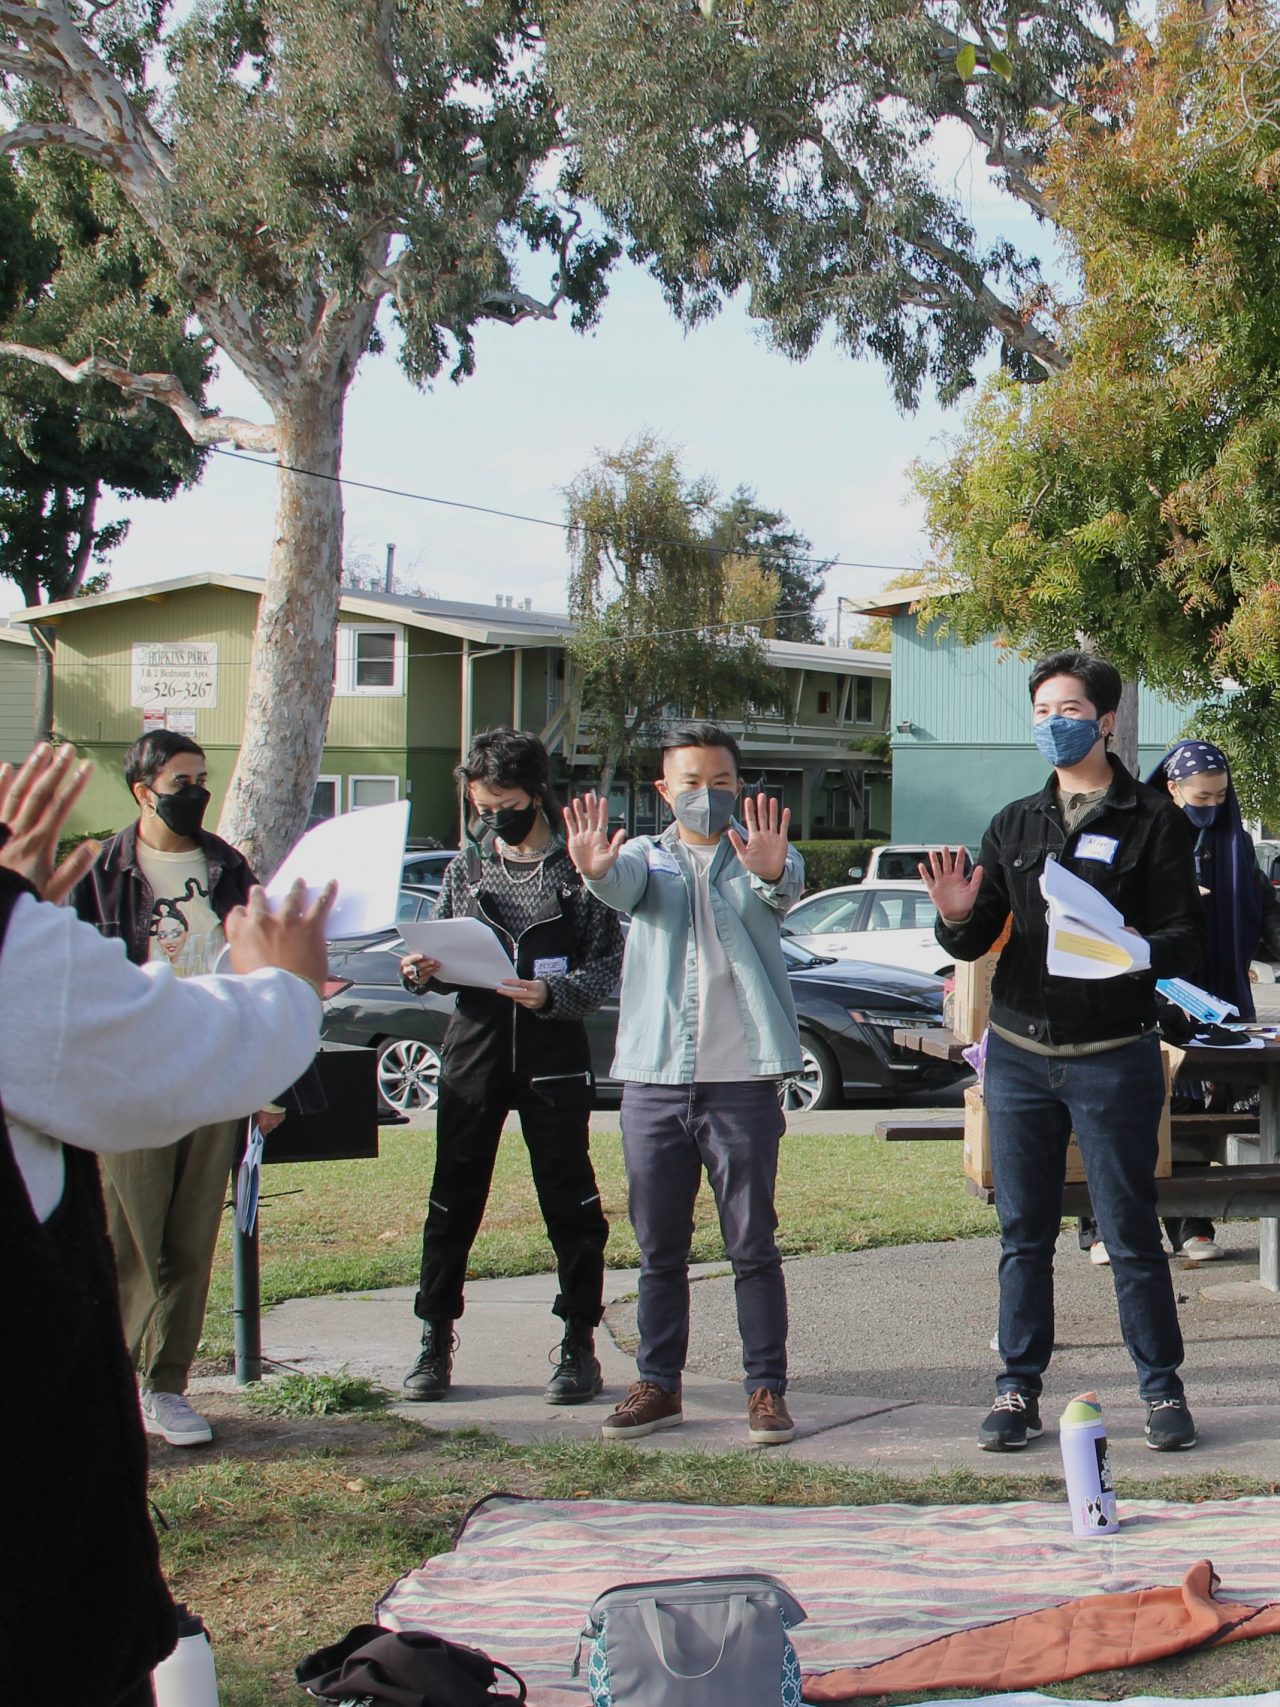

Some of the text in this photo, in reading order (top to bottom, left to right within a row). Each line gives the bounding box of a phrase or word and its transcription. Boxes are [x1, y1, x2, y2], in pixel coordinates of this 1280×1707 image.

[149, 651, 209, 665] HOPKINS PARK
[160, 669, 190, 678] Bedroom
[154, 682, 212, 700] 526-3267
[1203, 1010, 1214, 1021] 2
